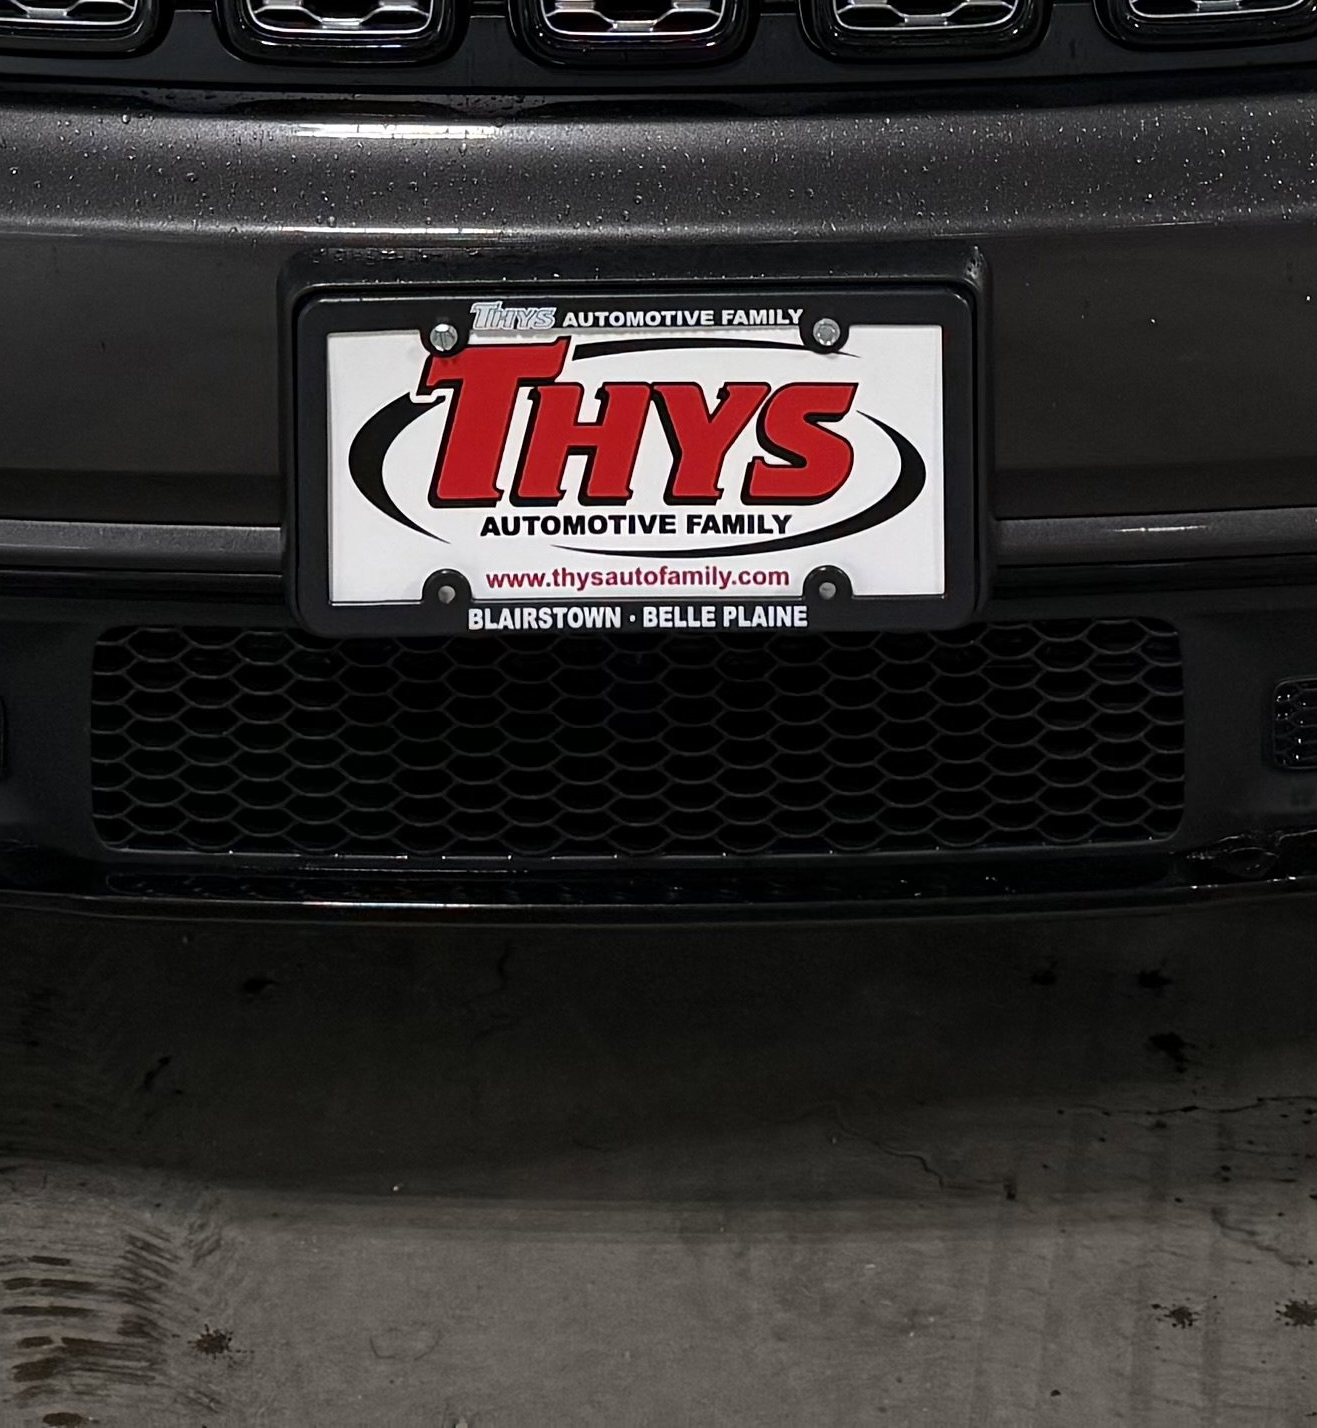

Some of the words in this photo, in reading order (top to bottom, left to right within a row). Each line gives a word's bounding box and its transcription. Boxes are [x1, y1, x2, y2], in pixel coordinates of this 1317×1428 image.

[470, 301, 557, 330] THYS
[562, 309, 715, 327] AUTOMOTIVE
[721, 308, 804, 325] FAMILY
[420, 337, 860, 507] THYS
[480, 515, 677, 537] AUTOMOTIVE
[686, 514, 793, 536] FAMILY
[485, 565, 790, 592] www.thysautofamily.com
[468, 606, 622, 631] BLAIRSTOWN
[643, 605, 719, 629] BELLE
[723, 605, 808, 629] PLAINE
